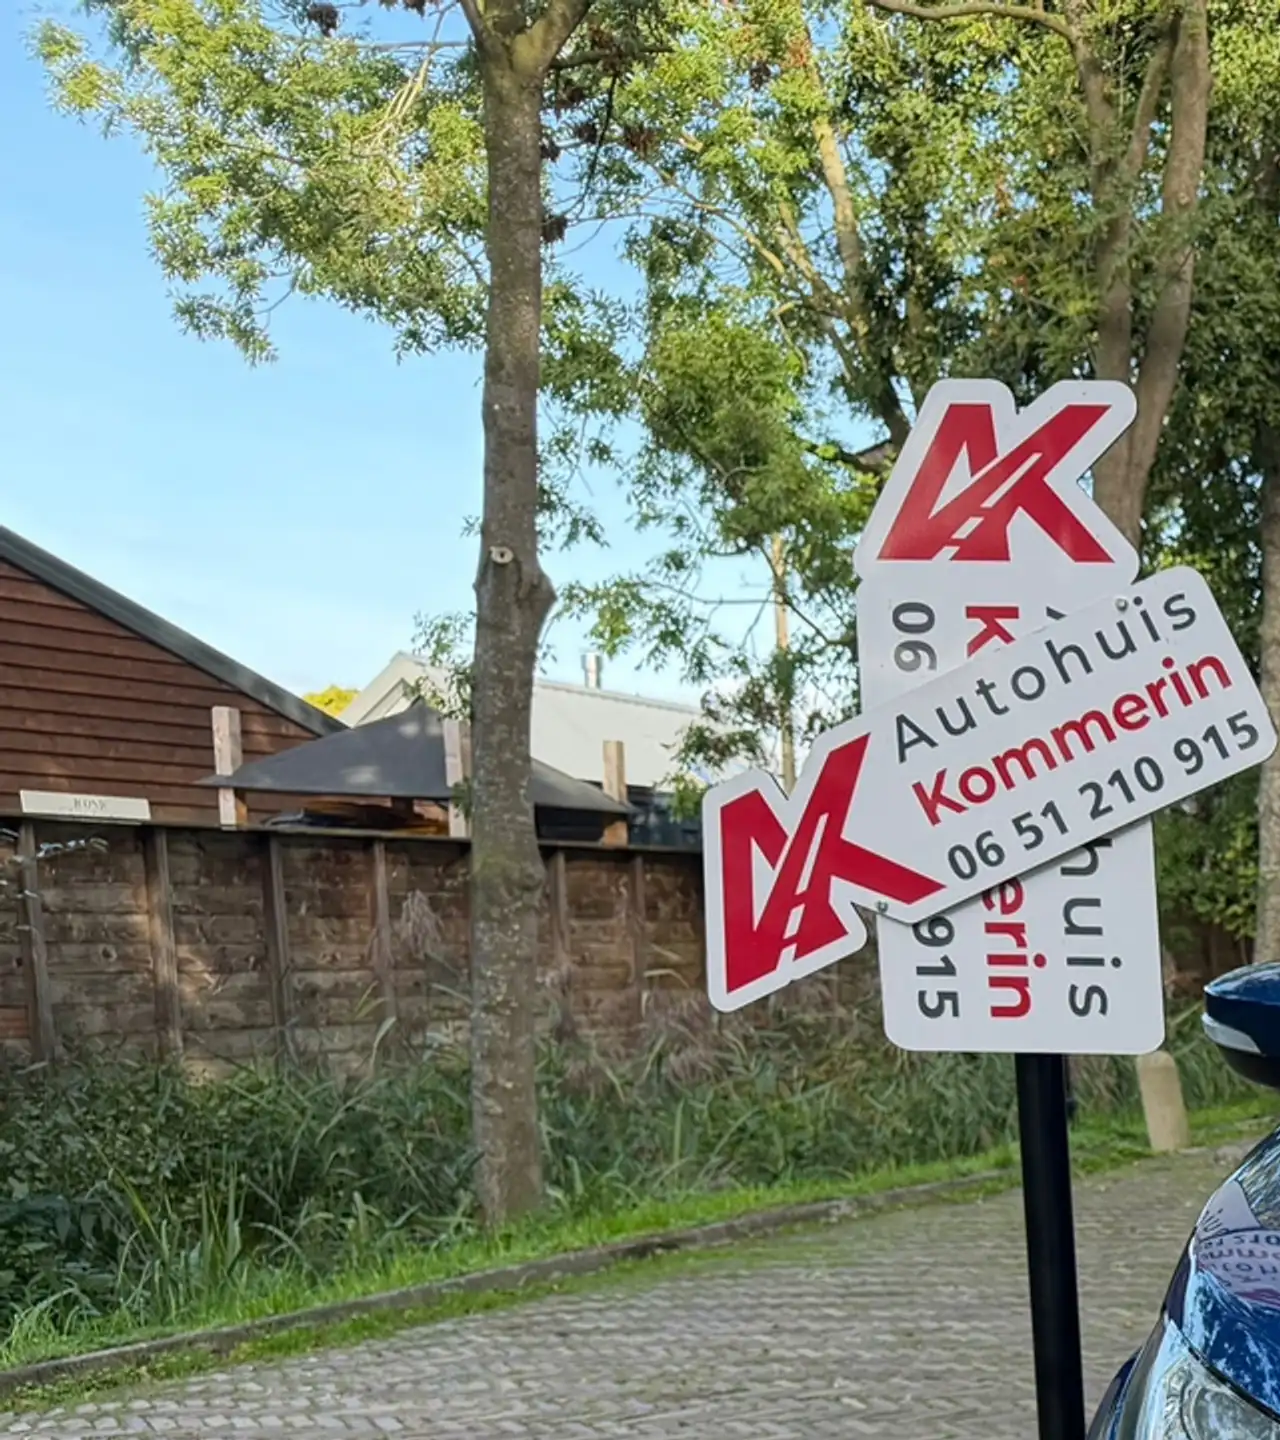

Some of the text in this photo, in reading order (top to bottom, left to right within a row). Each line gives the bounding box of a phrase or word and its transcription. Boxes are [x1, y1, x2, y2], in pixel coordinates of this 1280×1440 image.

[877, 403, 1113, 563] AK
[895, 592, 1197, 764] Autohuis
[911, 655, 1232, 827] Kommerin
[720, 732, 947, 994] AK
[892, 602, 959, 1019] 06 915
[947, 711, 1260, 881] 06 51 210 915
[1059, 837, 1122, 1017] huis
